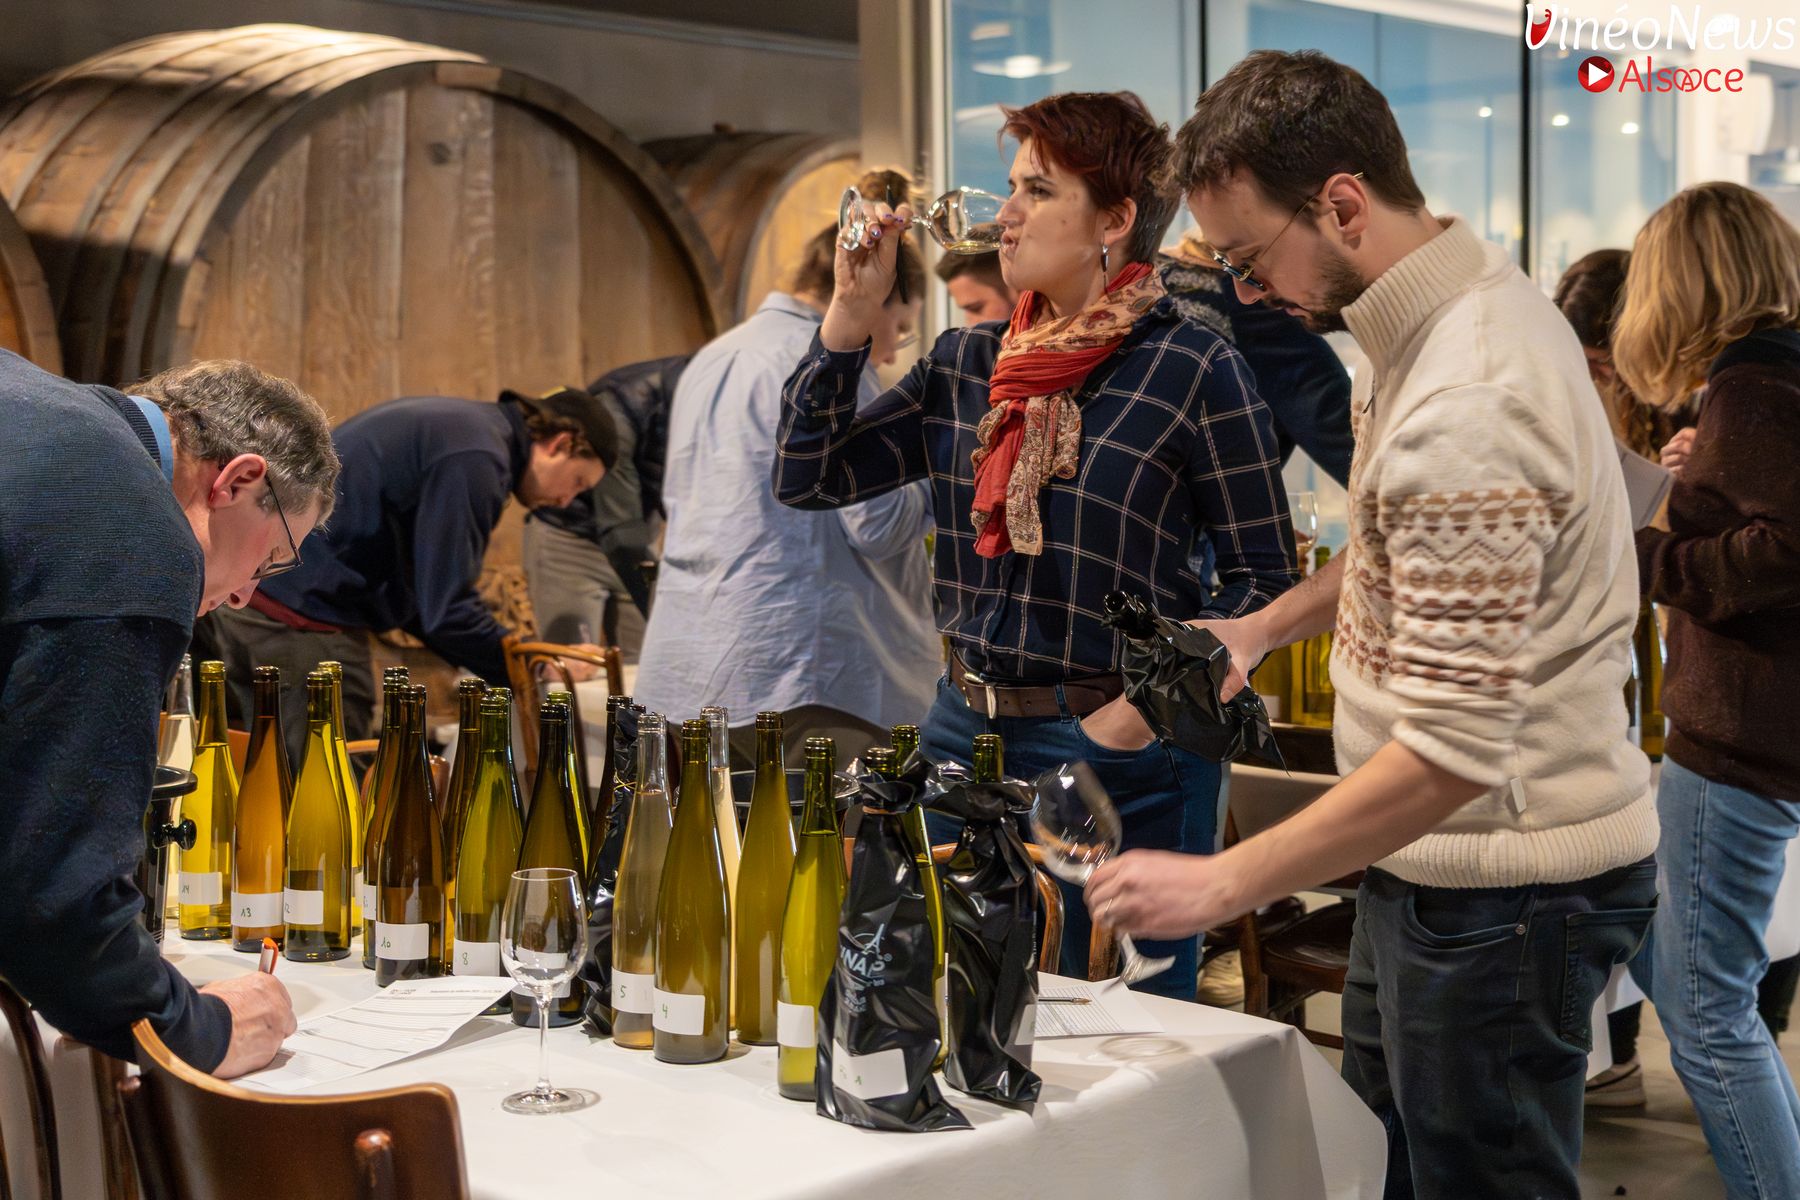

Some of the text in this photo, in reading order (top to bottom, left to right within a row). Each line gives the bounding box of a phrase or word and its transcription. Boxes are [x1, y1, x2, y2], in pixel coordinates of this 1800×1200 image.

[240, 907, 252, 918] 13
[461, 952, 469, 966] 8
[620, 985, 627, 998] 5
[662, 1003, 668, 1019] 4
